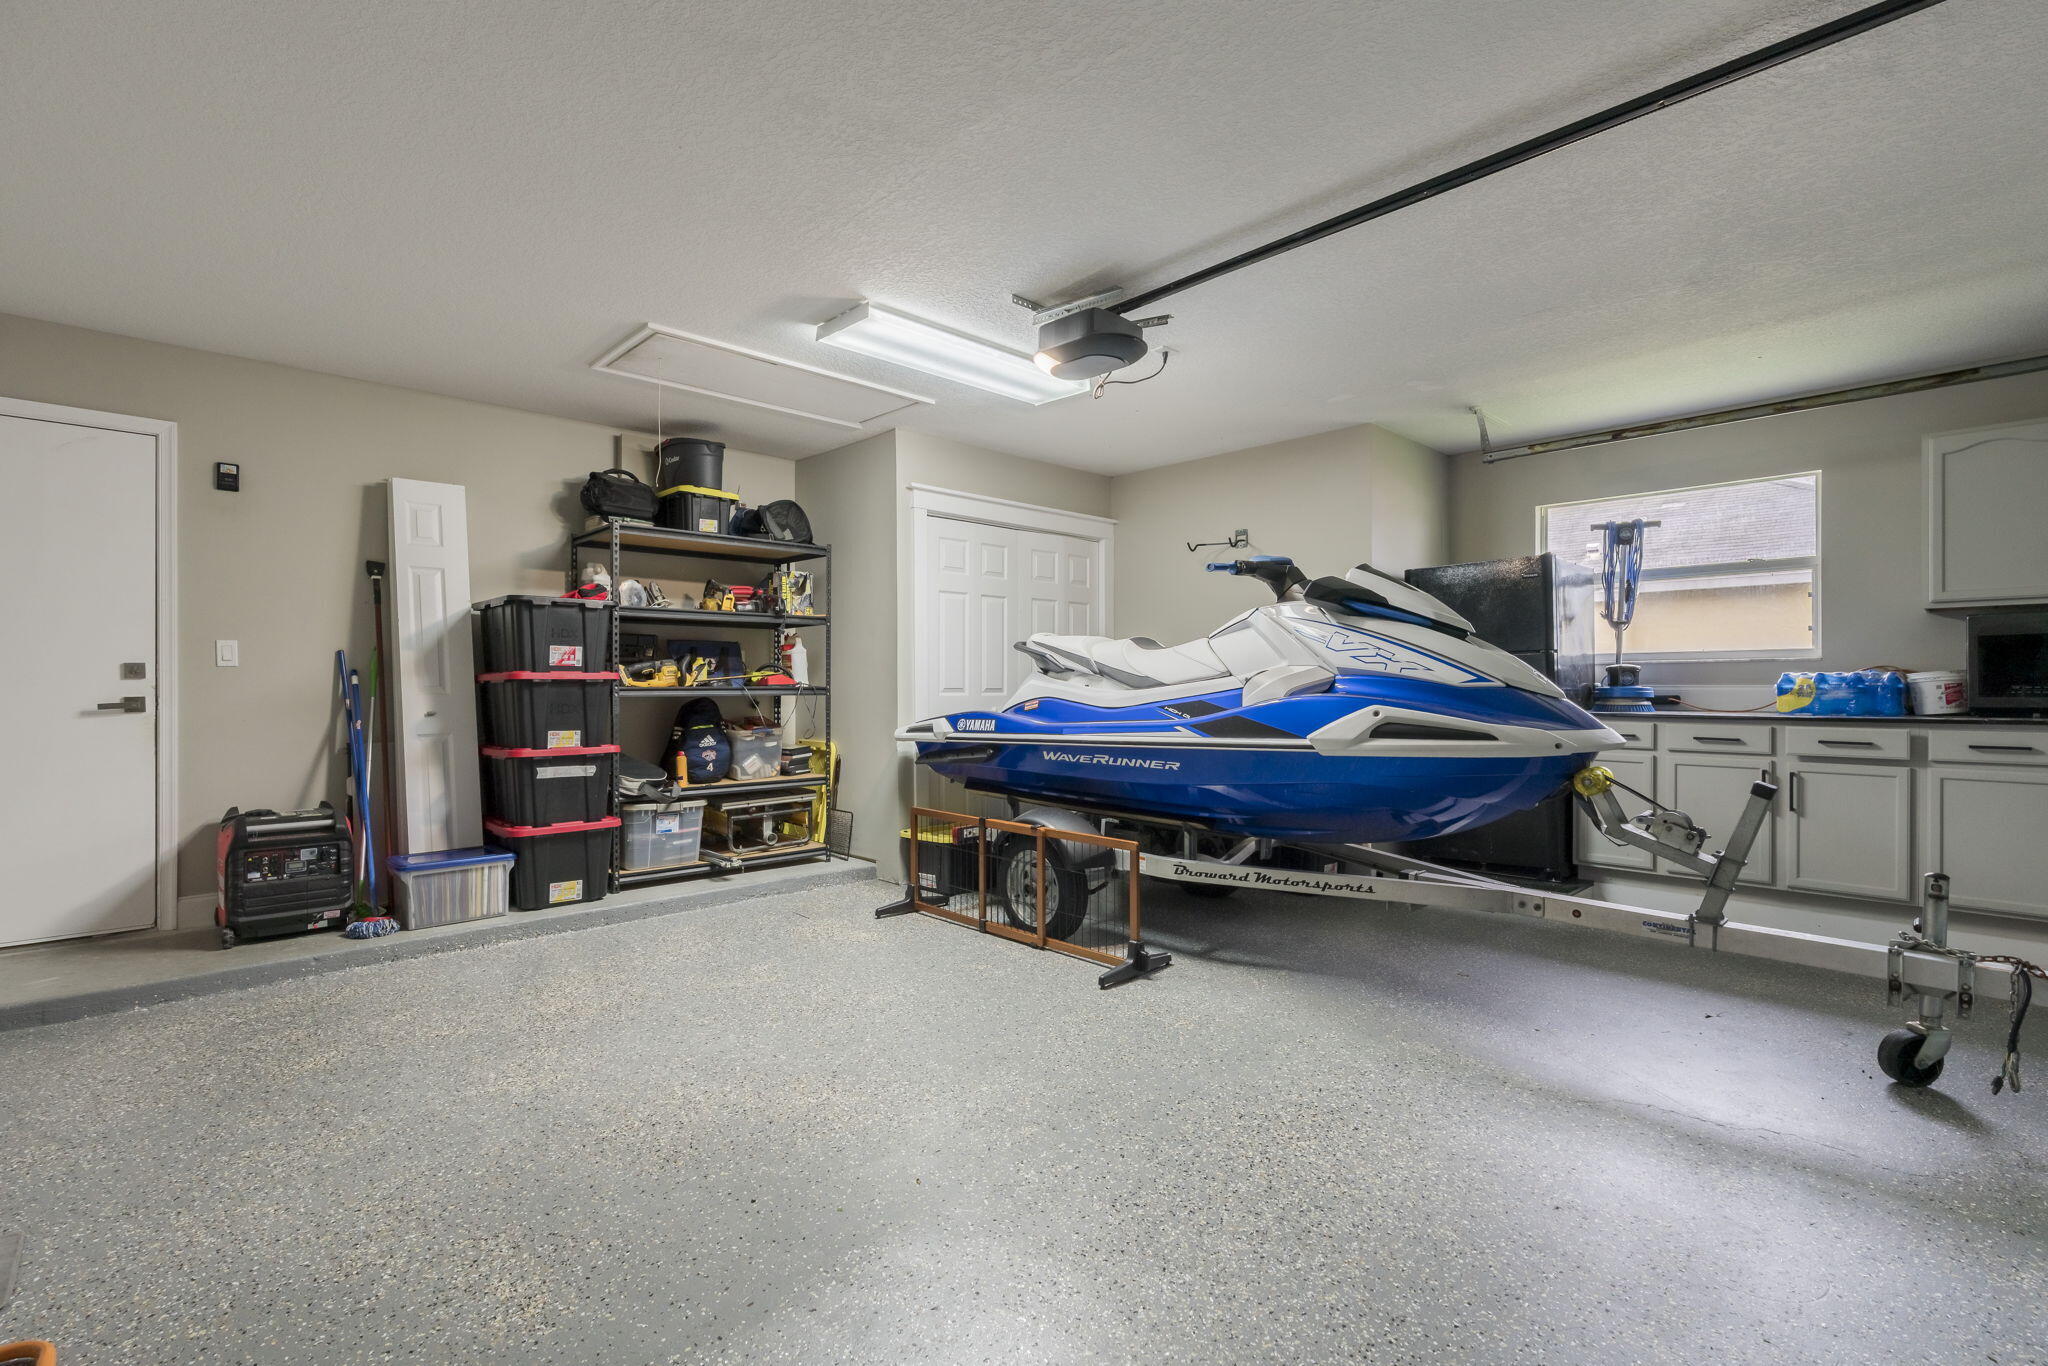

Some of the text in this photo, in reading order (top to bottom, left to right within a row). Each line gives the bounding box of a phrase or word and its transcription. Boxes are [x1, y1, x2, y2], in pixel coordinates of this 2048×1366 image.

[966, 719, 995, 731] YAMAHA
[706, 762, 714, 772] 4
[1173, 863, 1376, 895] Broward Motorsports
